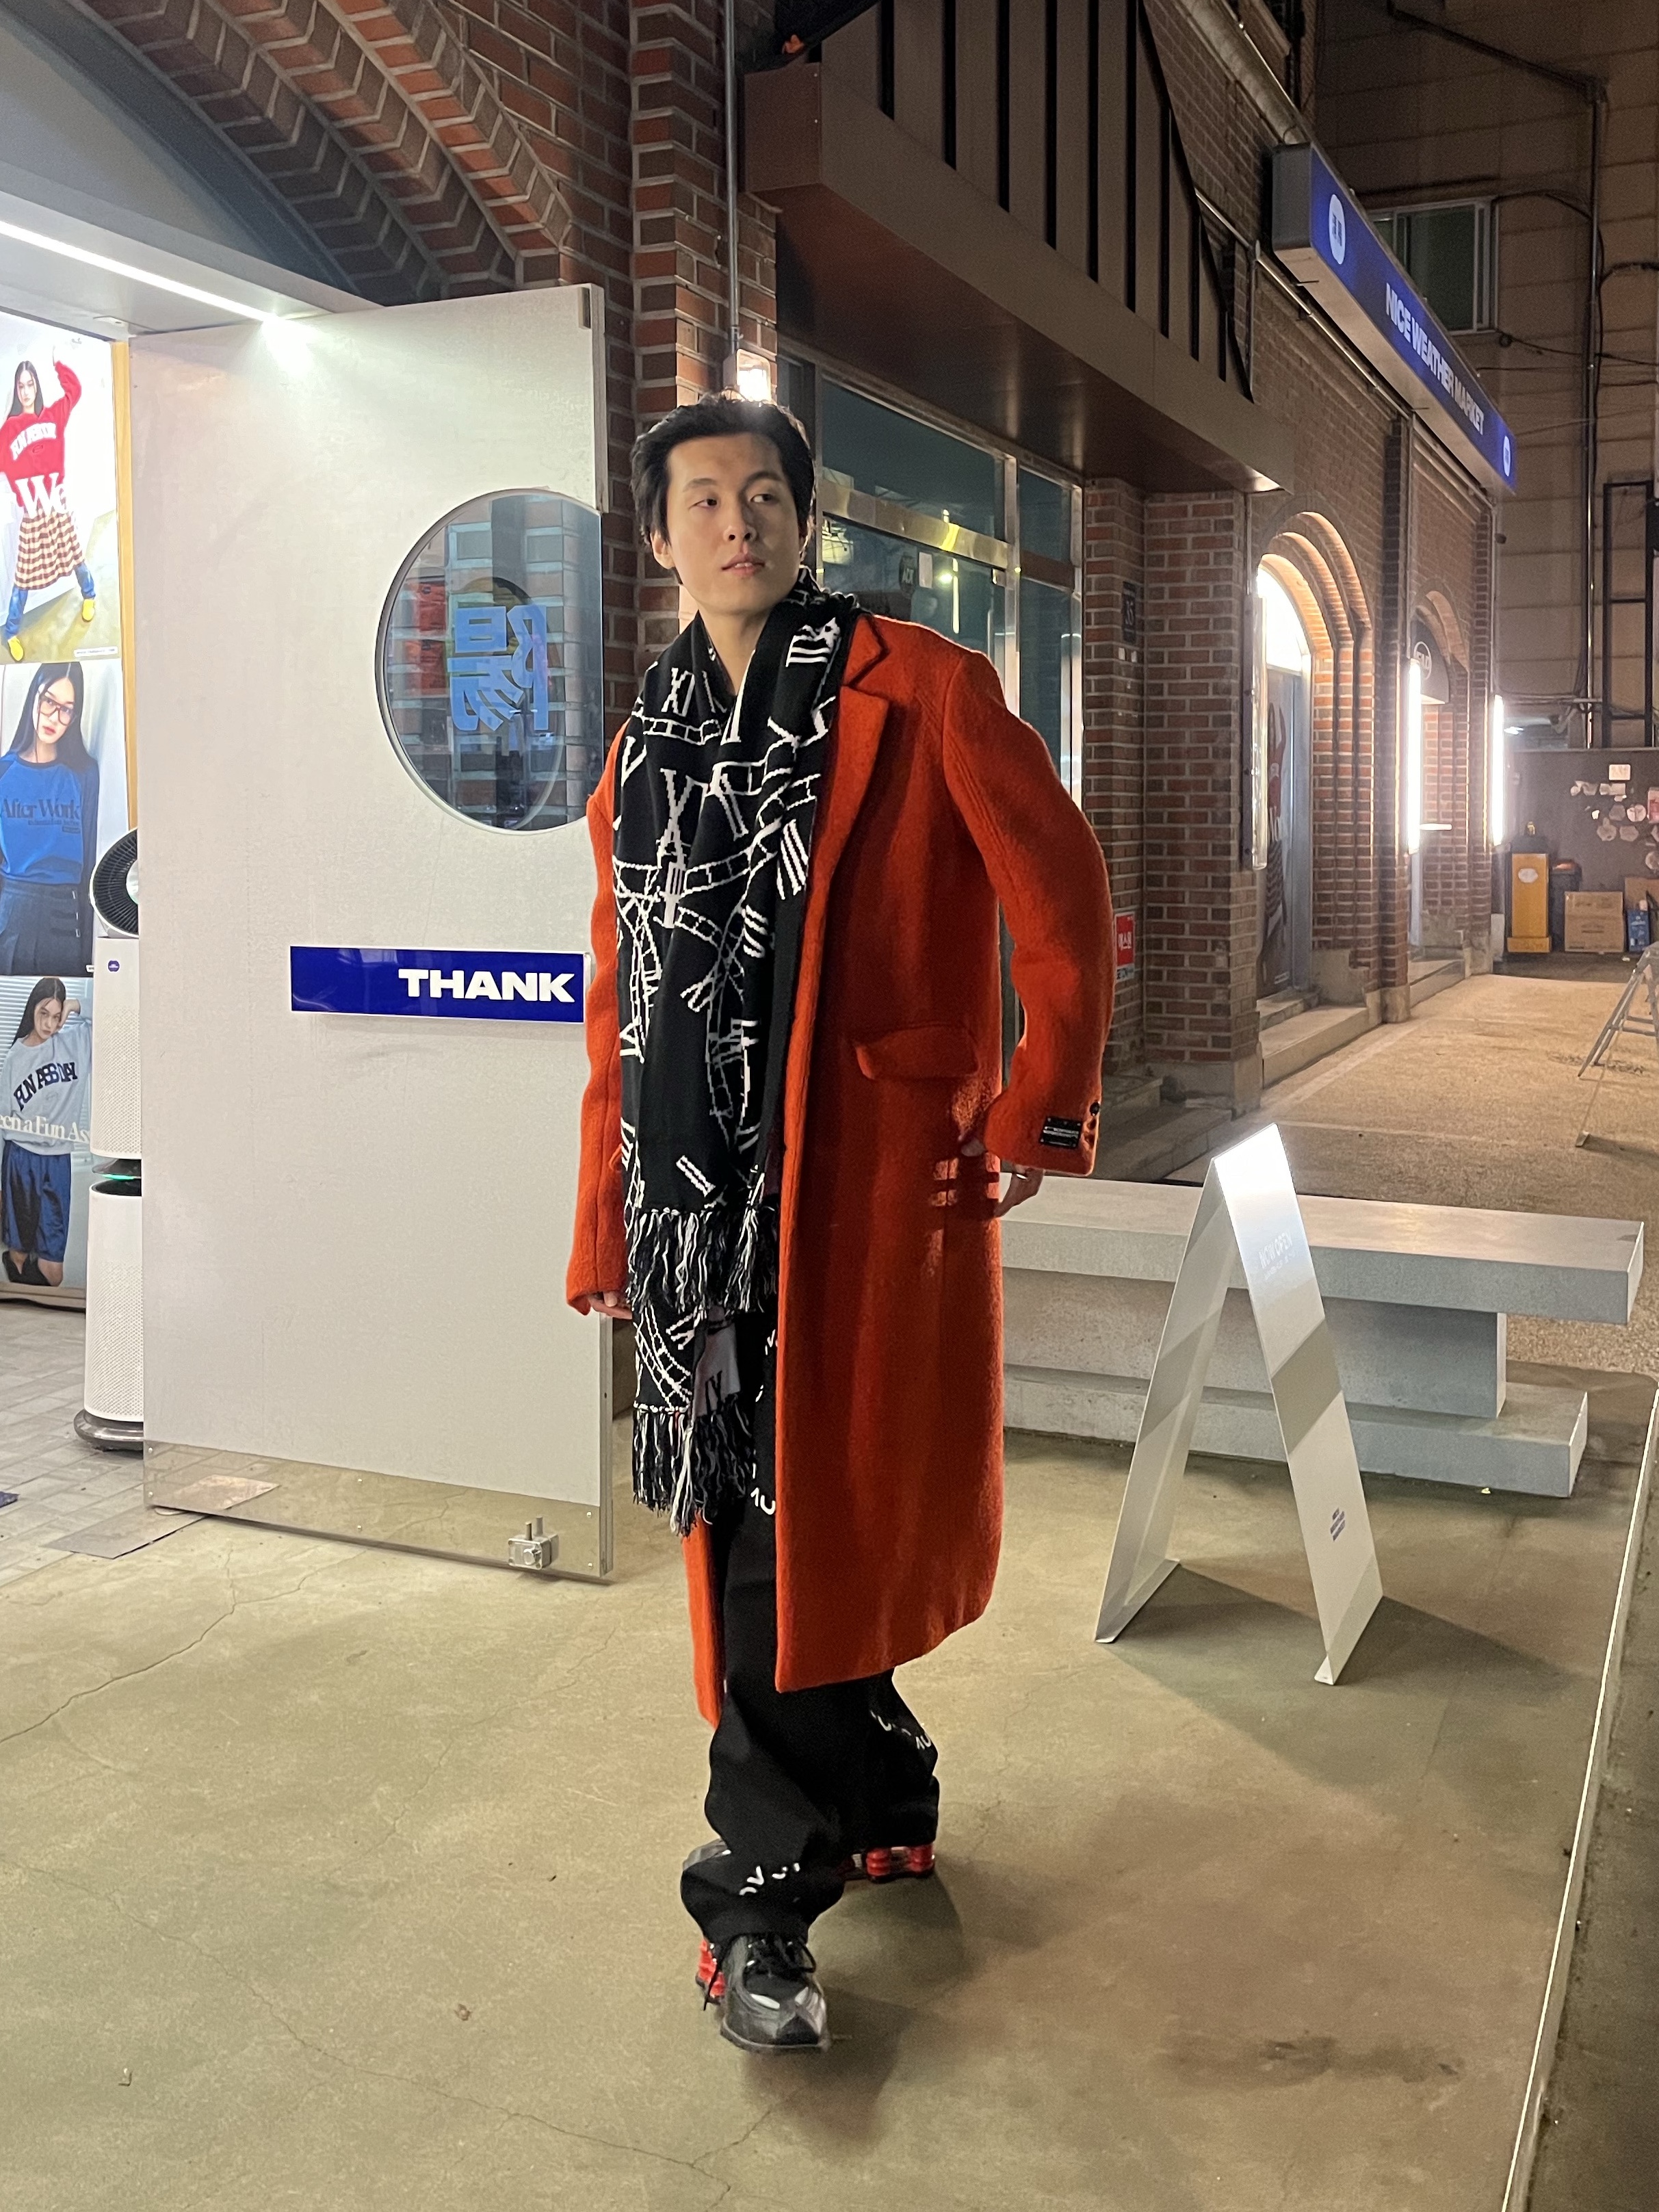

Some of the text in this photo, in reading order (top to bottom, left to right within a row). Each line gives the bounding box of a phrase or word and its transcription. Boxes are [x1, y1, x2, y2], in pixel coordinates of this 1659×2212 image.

[1386, 283, 1485, 435] NICE WEATHER MARKET
[3, 798, 80, 820] After Work
[398, 968, 575, 1002] THANK
[35, 1115, 65, 1139] Fun
